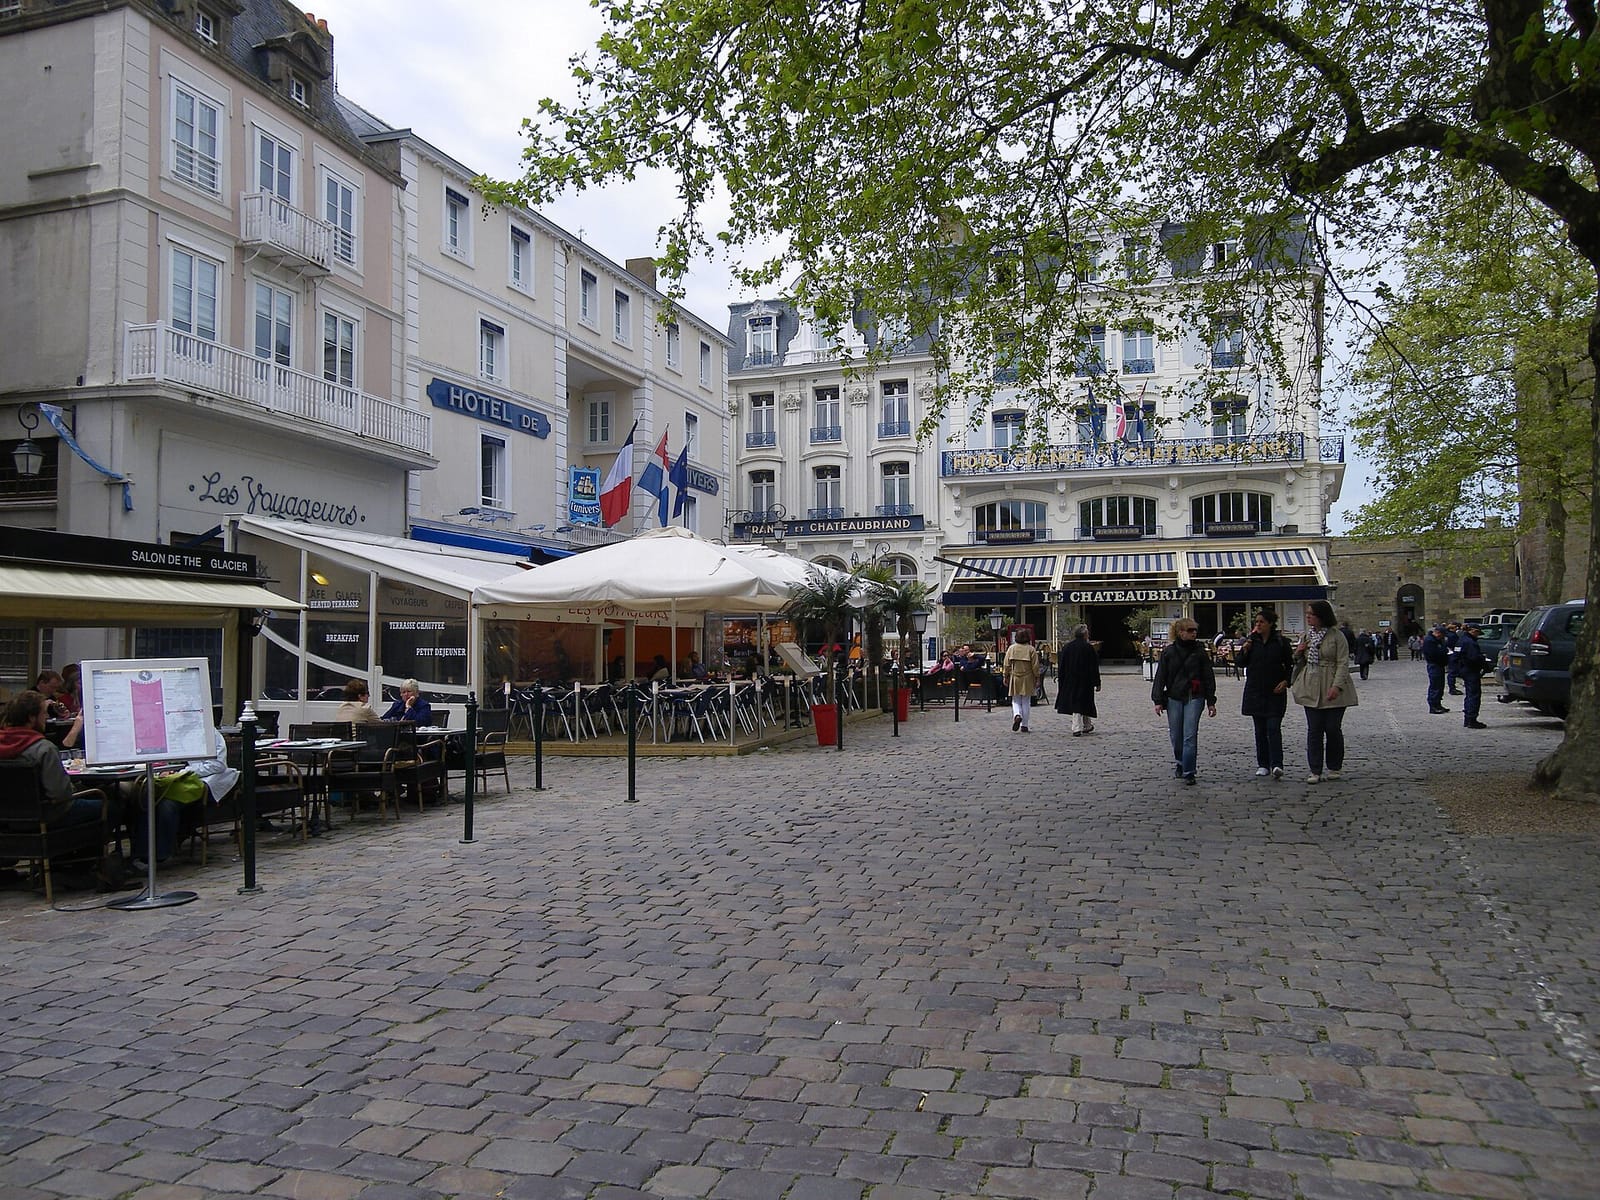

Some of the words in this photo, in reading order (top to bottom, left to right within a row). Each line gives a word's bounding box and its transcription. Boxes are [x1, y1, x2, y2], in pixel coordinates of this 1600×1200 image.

[449, 386, 512, 423] HOTEL
[521, 413, 539, 432] DE
[952, 453, 1009, 470] HOTEL
[1015, 450, 1085, 465] FRANCE
[1125, 439, 1290, 462] CHATEAUBRAND
[687, 469, 716, 490] IVERS
[199, 471, 239, 506] Les
[241, 475, 357, 526] Voyageurs
[744, 524, 788, 534] RANE
[809, 519, 911, 532] CHATEAUBRIAND
[131, 550, 166, 564] SALON
[167, 553, 182, 566] DE
[182, 555, 202, 568] THE
[210, 558, 248, 573] GLACIER
[308, 589, 326, 599] AFE
[1069, 589, 1216, 602] CHATEAUBRIAND
[310, 600, 331, 609] HEATED
[331, 600, 360, 608] TERRASSE
[389, 621, 416, 630] TERRASSE
[416, 621, 446, 630] CHAUFFEE
[325, 633, 360, 643] BREAKFAST
[416, 647, 434, 656] PETIT
[434, 647, 467, 658] DEJEUNER
